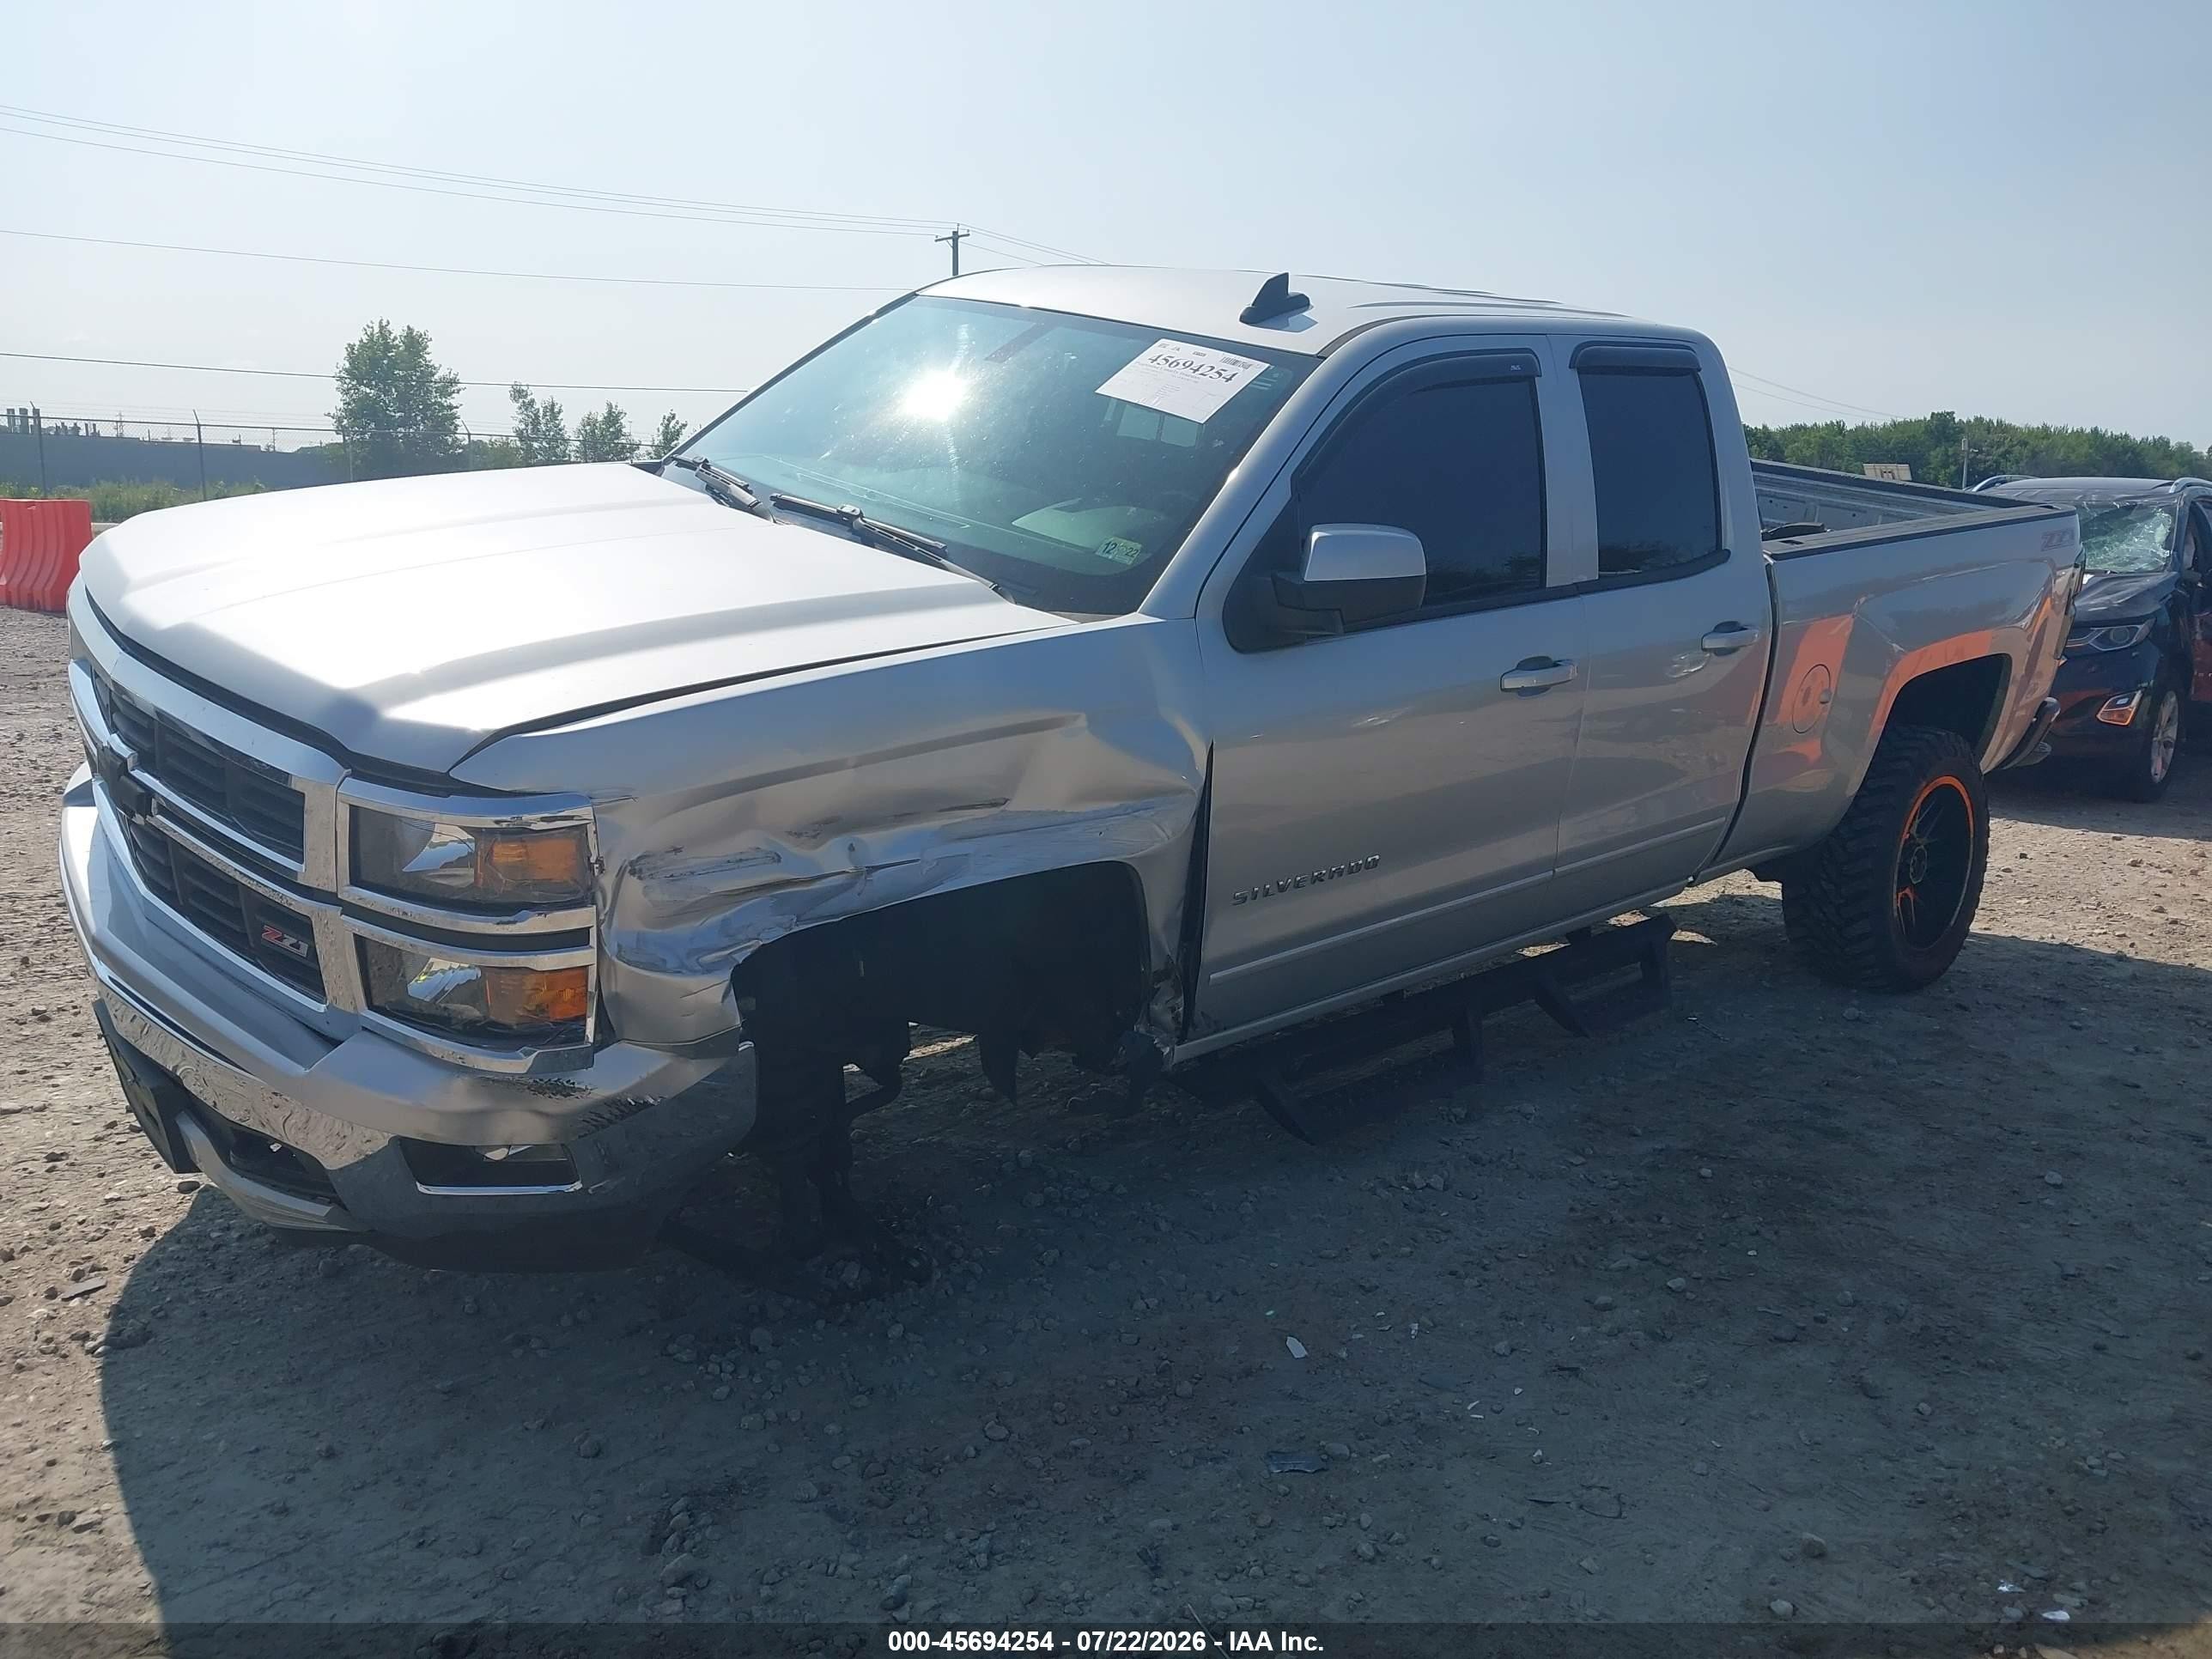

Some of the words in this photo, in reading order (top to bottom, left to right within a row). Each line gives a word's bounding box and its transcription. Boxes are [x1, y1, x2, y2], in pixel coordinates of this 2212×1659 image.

[1148, 353, 1239, 383] 45694254
[1103, 541, 1118, 556] 12
[1125, 547, 1139, 558] 22
[1232, 853, 1381, 906] SILVERADO
[261, 925, 309, 957] Z71
